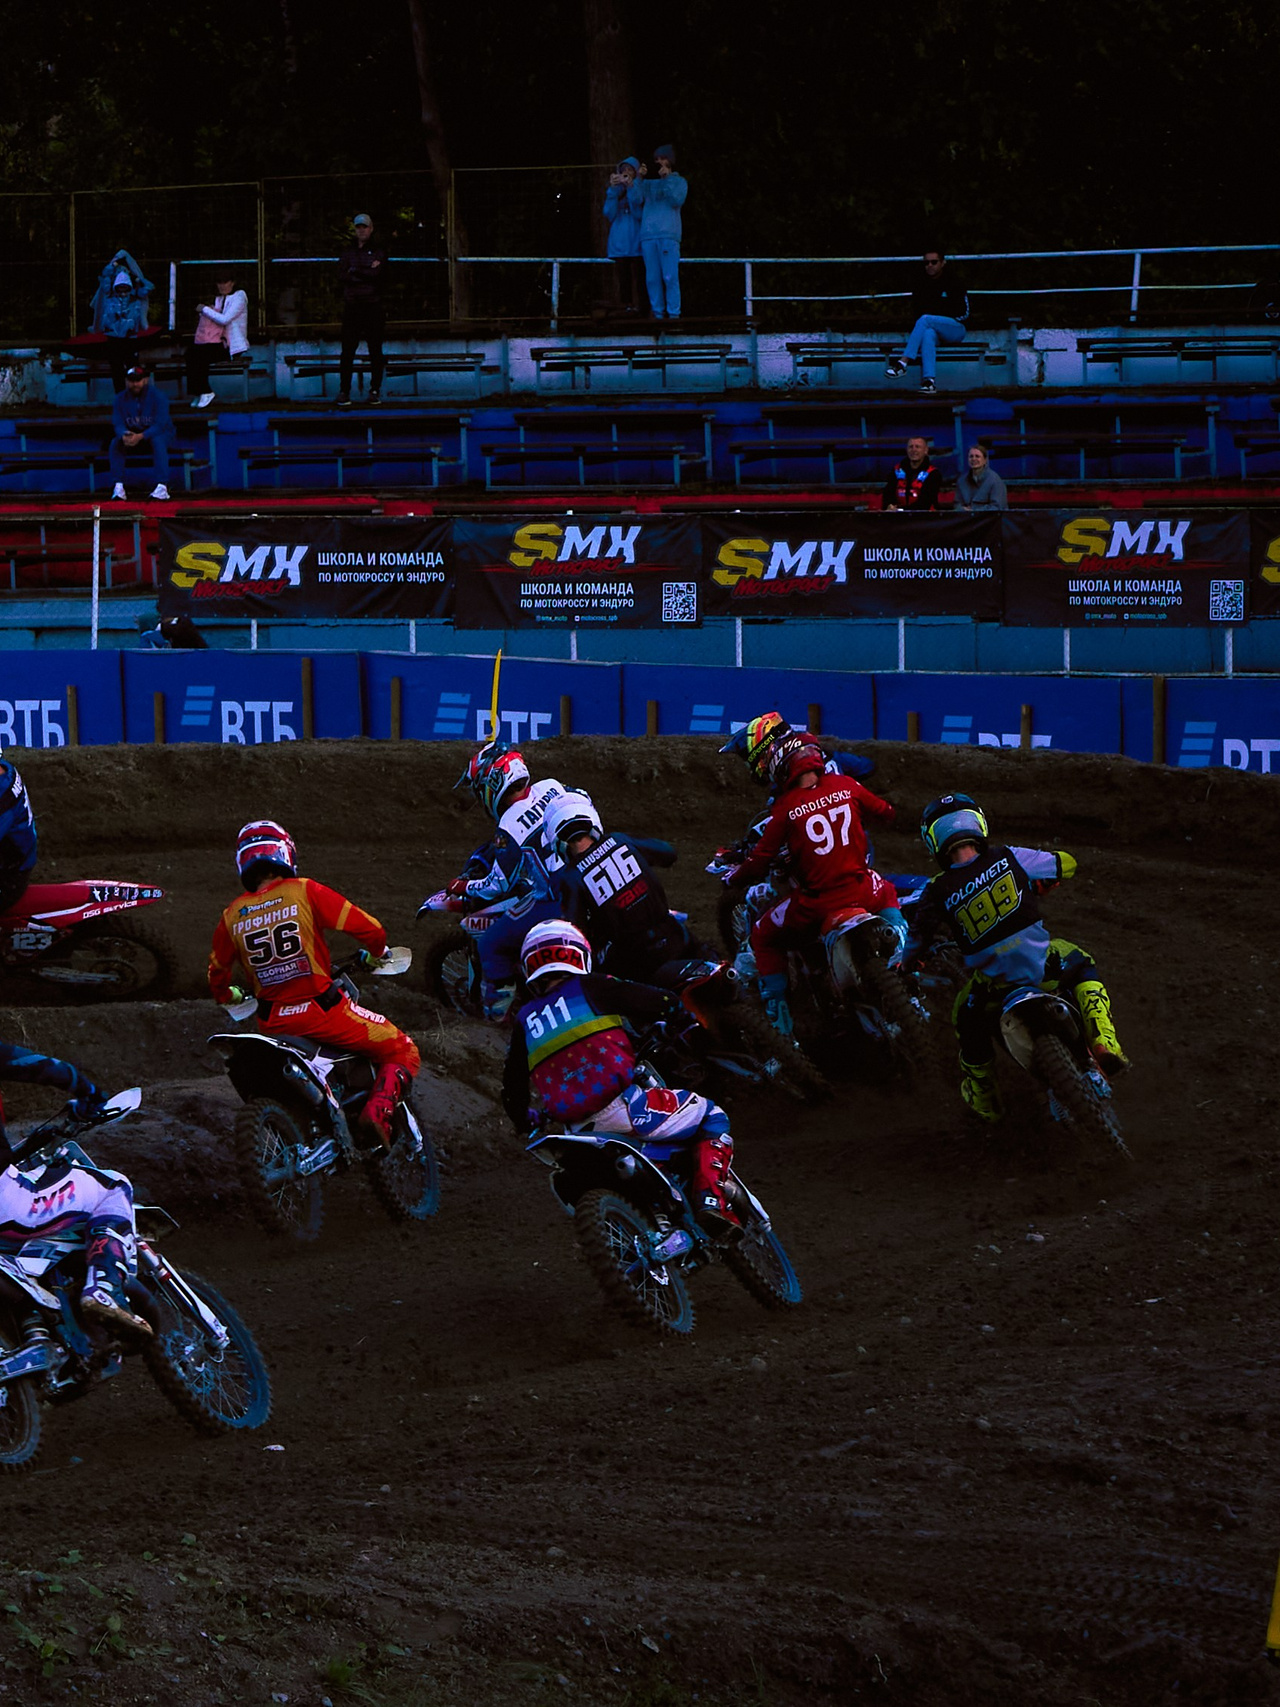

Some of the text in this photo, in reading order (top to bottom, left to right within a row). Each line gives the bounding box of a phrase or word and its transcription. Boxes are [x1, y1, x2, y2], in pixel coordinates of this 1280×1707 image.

[509, 523, 642, 567] SMX
[863, 547, 993, 564] ШКОЛА И КОМАНДА
[1058, 518, 1192, 563] SMX
[171, 542, 309, 588] SMX
[317, 551, 445, 568] ШКОЛА И КОМАНДА
[712, 538, 855, 585] SMX
[864, 567, 993, 580] ПО МОТОКРОССУ И ЭНДУРО
[318, 571, 445, 584] ПО МОТОКРОССУ И ЭНДУРО
[520, 582, 635, 597] ШКОЛА И КОМАНДА
[1068, 579, 1183, 595] ШКОЛА И КОМАНДА
[520, 599, 635, 610] ПО МОТОКРОССУ И ЭНДУРО
[1069, 596, 1183, 607] ПО МОТОКРОССУ И ЭНДУРО
[805, 803, 852, 856] 97
[576, 837, 618, 873] KLIUSHKIN
[582, 844, 643, 908] 616
[944, 857, 1010, 912] KOLOMIETS
[232, 904, 298, 936] ТРОФИМОВ
[954, 870, 1023, 945] 199
[10, 932, 53, 950] 123
[243, 920, 303, 966] 56
[257, 961, 297, 979] СБОРНАЯ
[526, 996, 572, 1039] 511
